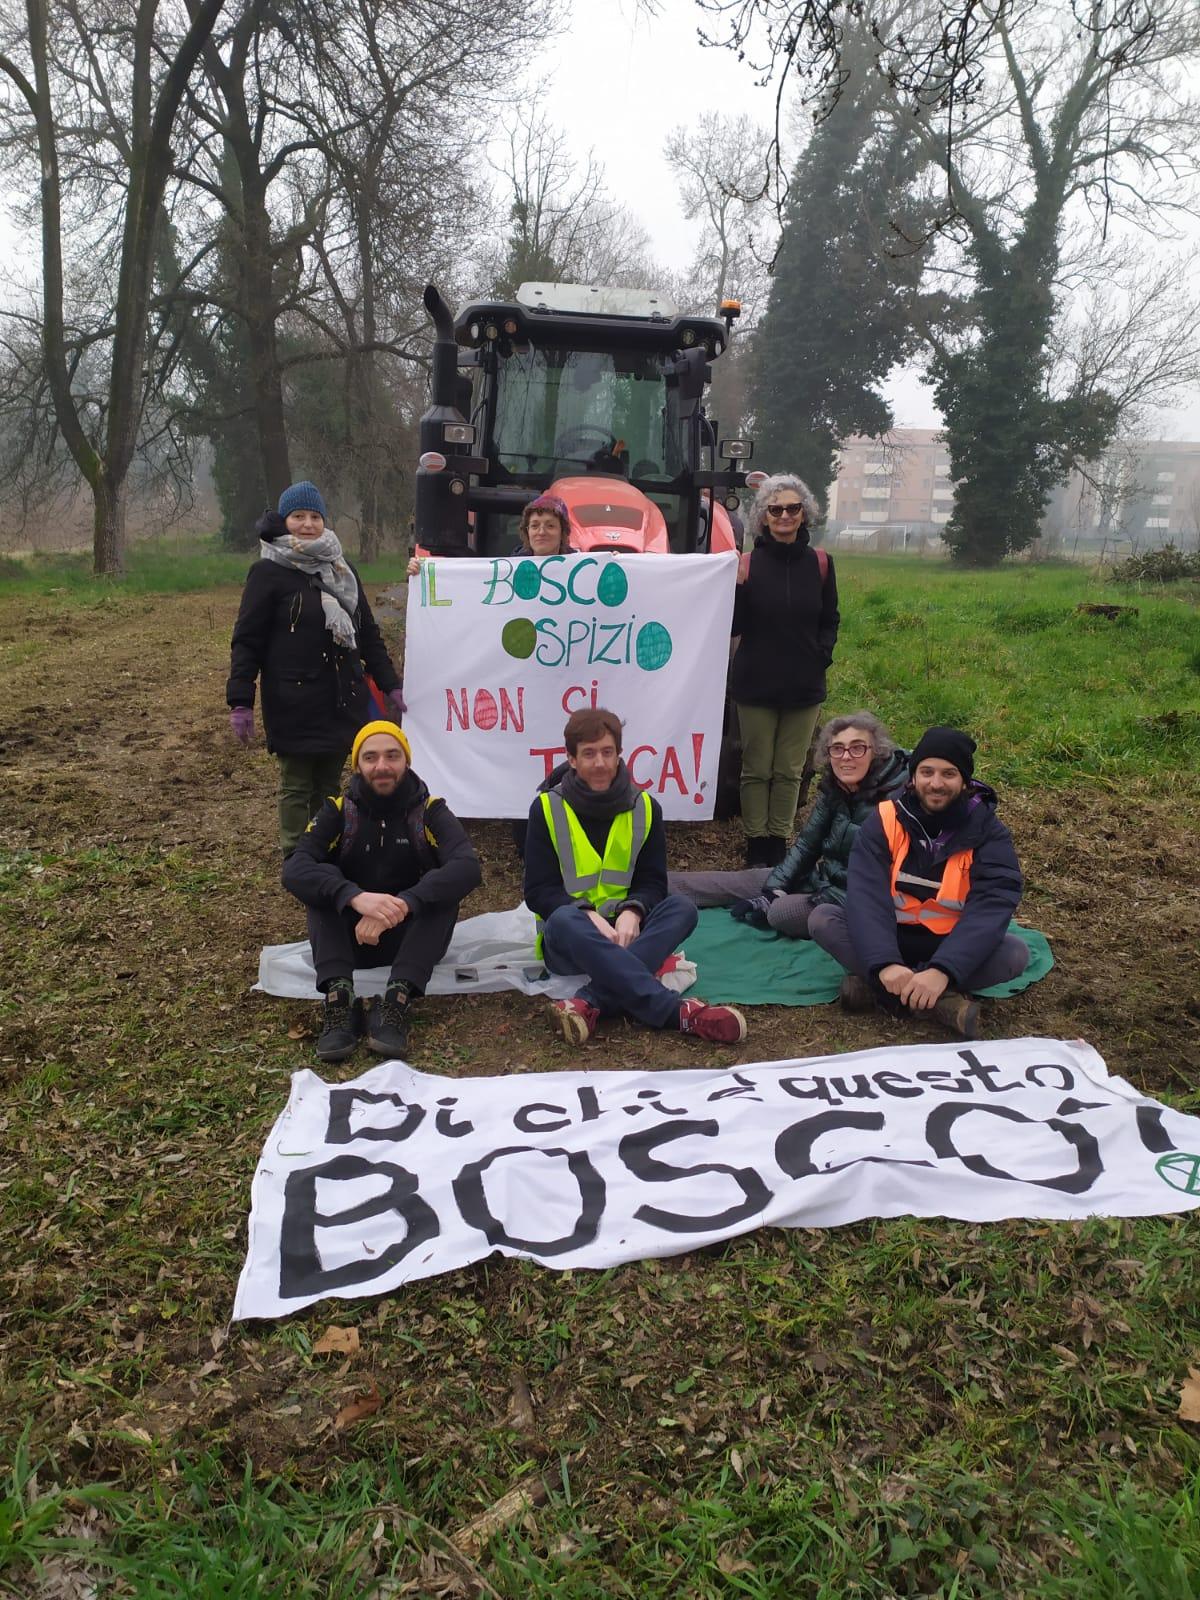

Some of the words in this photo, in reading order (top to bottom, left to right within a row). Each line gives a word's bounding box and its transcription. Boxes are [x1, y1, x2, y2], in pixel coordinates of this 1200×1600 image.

[419, 556, 453, 608] IL
[481, 555, 629, 608] BOSCO
[444, 686, 526, 733] NON
[529, 732, 705, 805] TCA!
[324, 1087, 475, 1144] Di
[778, 1049, 1076, 1105] questo
